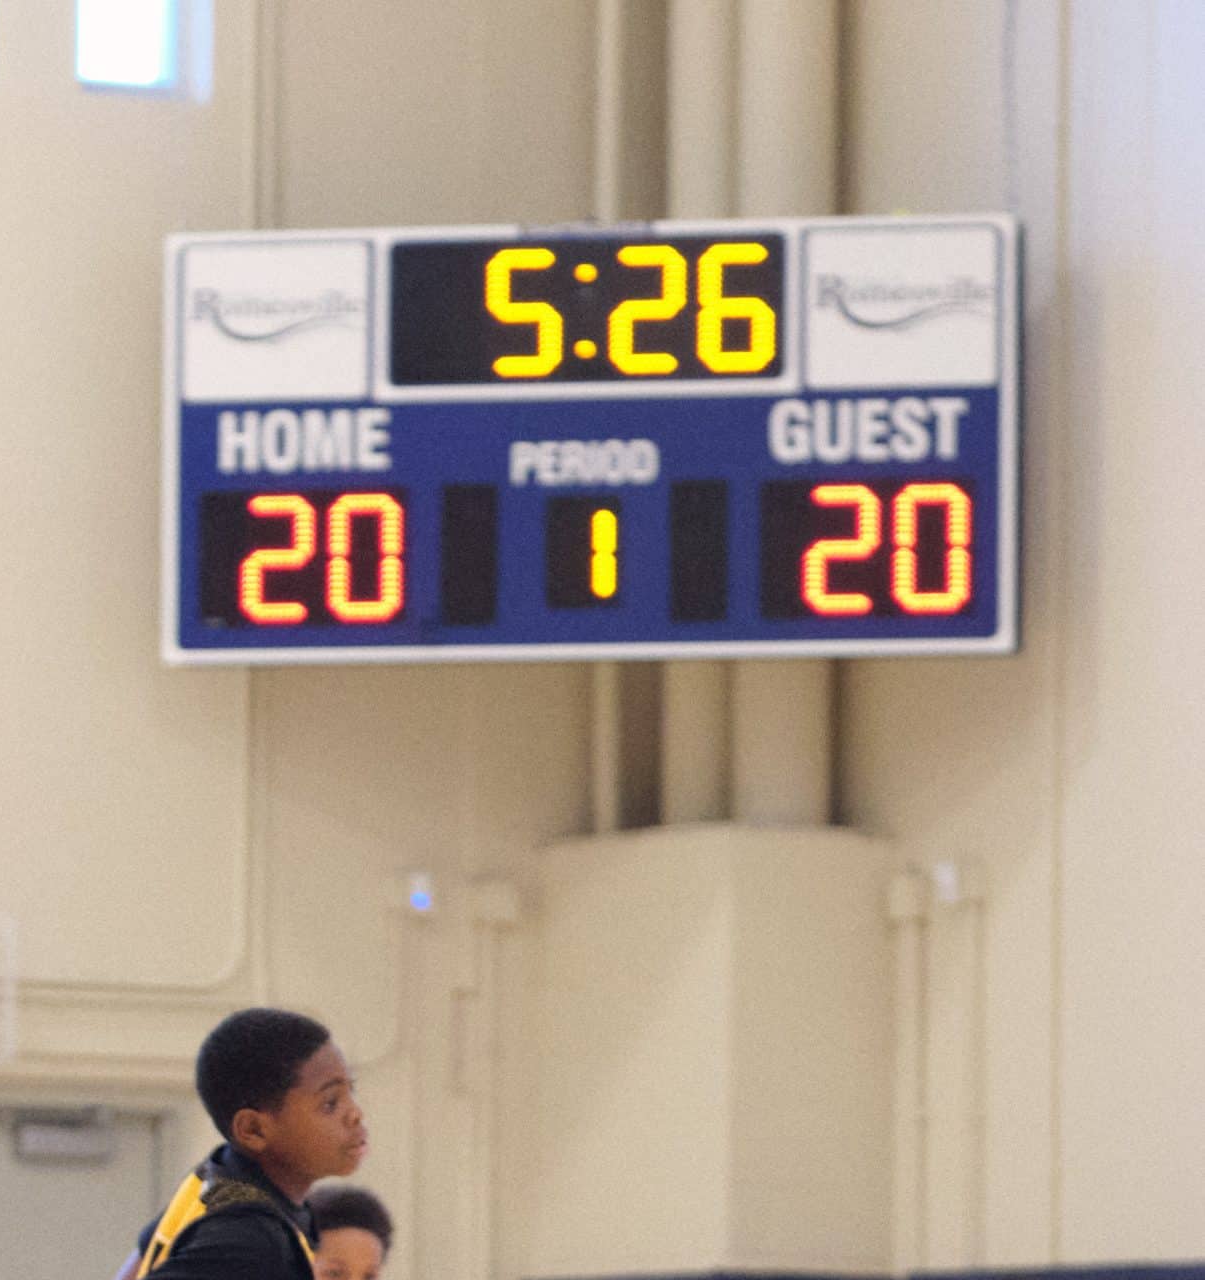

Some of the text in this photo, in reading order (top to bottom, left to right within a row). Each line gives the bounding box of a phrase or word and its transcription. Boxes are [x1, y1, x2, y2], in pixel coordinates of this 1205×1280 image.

[485, 243, 776, 378] 5:26
[217, 408, 392, 474] HOME
[509, 438, 660, 486] PERIOD
[768, 396, 968, 464] GUEST
[240, 492, 405, 625] 20
[591, 508, 617, 599] 1
[803, 482, 971, 616] 20
